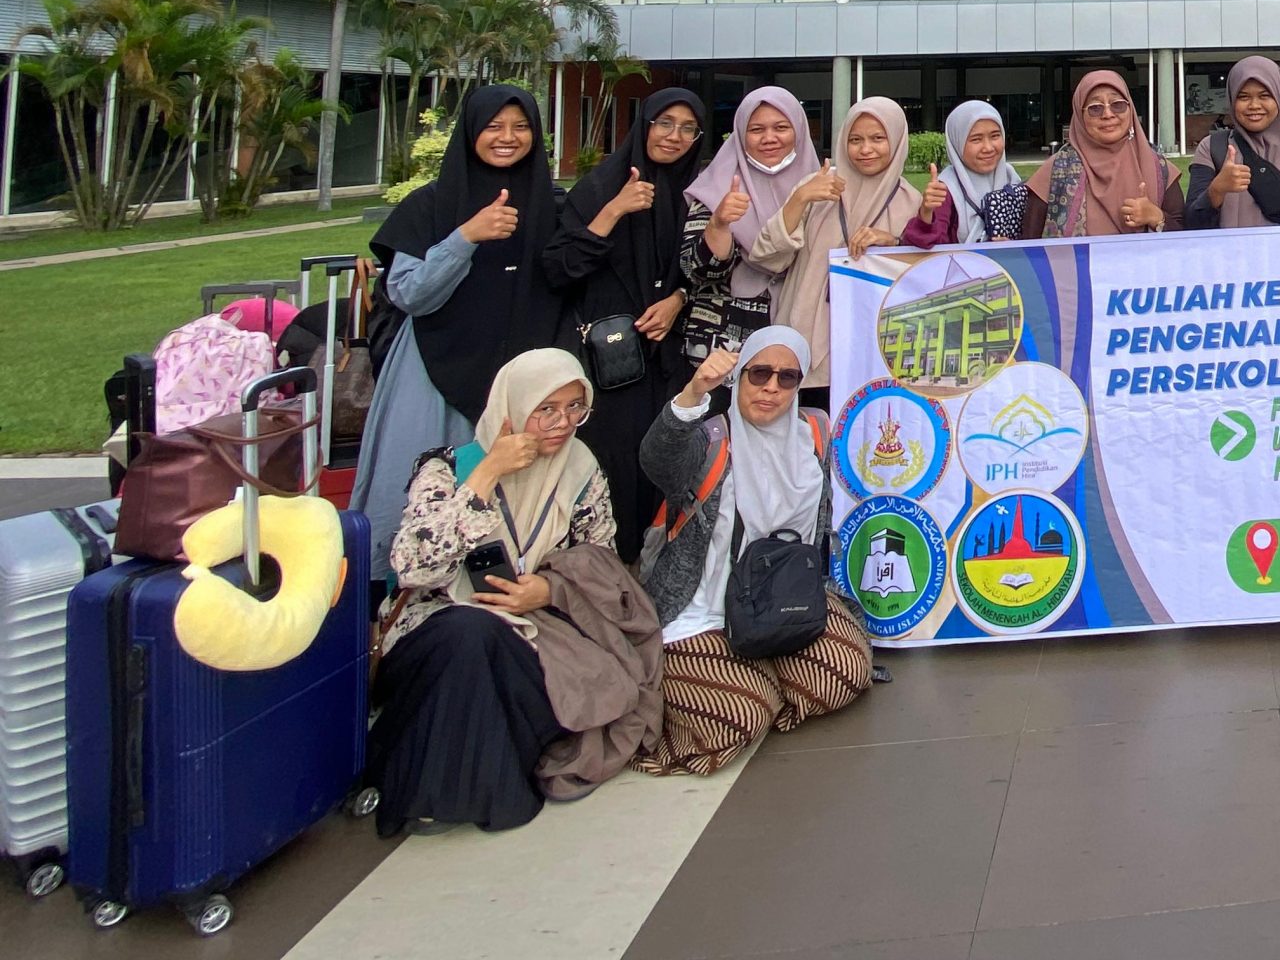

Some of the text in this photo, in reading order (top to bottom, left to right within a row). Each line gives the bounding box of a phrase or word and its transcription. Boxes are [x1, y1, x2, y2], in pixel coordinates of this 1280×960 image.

[1106, 283, 1235, 316] KULIAH
[986, 462, 1018, 481] IPH
[1022, 465, 1058, 473] Pendidikan
[898, 606, 928, 632] ISLAM
[926, 559, 945, 607] AL-AMIN
[957, 572, 982, 612] SEKOLAH
[980, 605, 1030, 625] MENENGAH
[1031, 608, 1043, 622] AL
[1048, 568, 1075, 608] HIDAYAH
